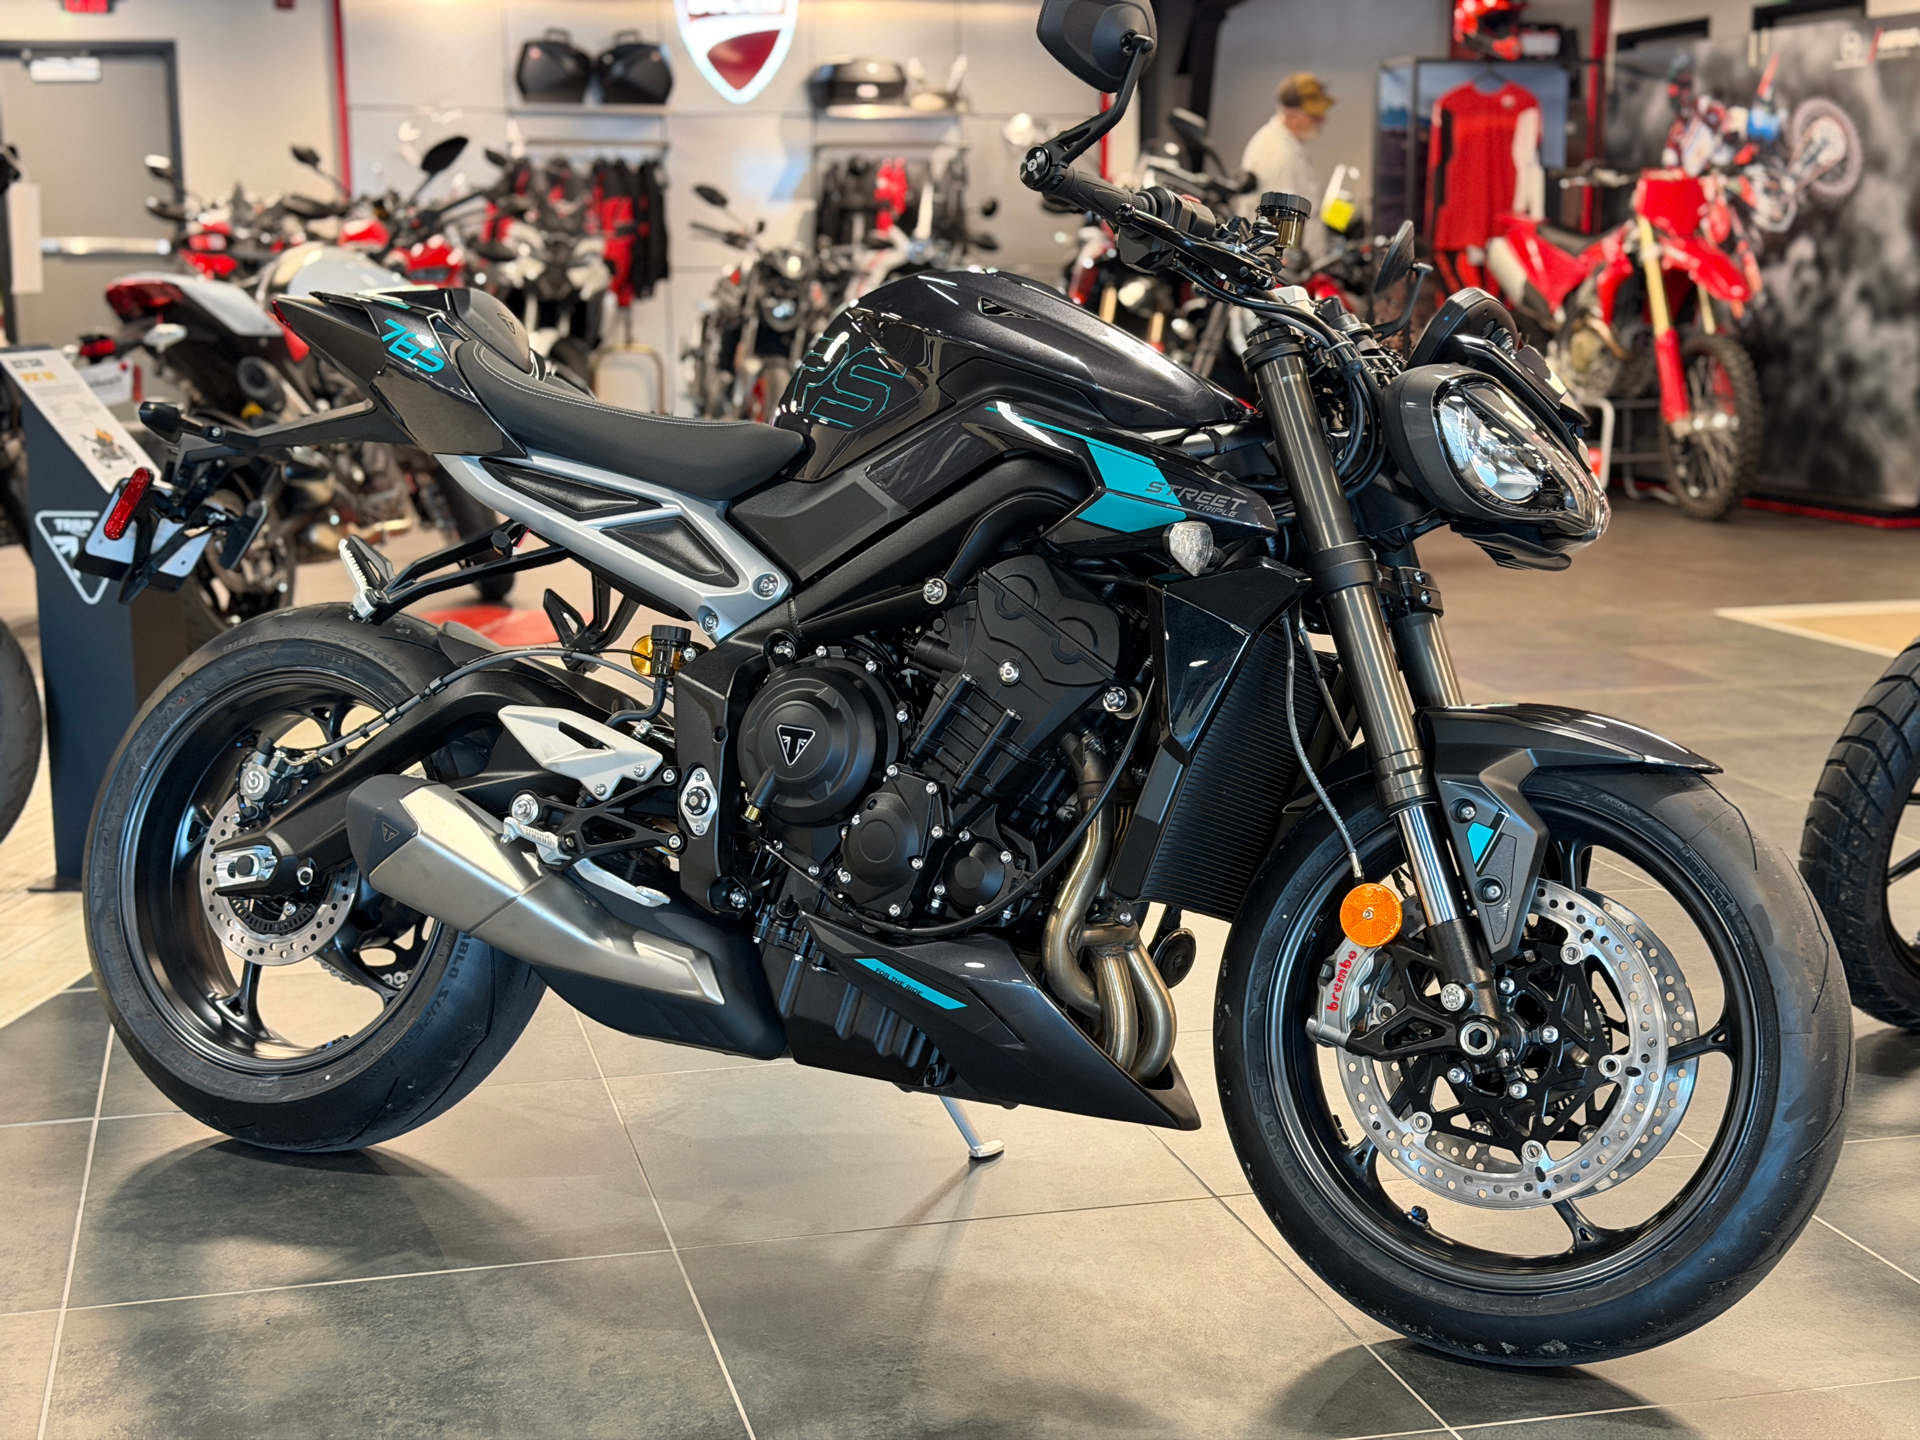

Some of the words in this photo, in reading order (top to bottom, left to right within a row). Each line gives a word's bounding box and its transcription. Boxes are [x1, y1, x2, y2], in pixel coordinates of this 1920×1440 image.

[381, 318, 445, 373] 765
[1145, 481, 1248, 511] STREET
[1197, 503, 1238, 518] TRIPLE
[875, 967, 891, 981] FOR
[891, 976, 905, 986] THE
[905, 983, 924, 996] RIDE
[1326, 950, 1358, 1012] brembo
